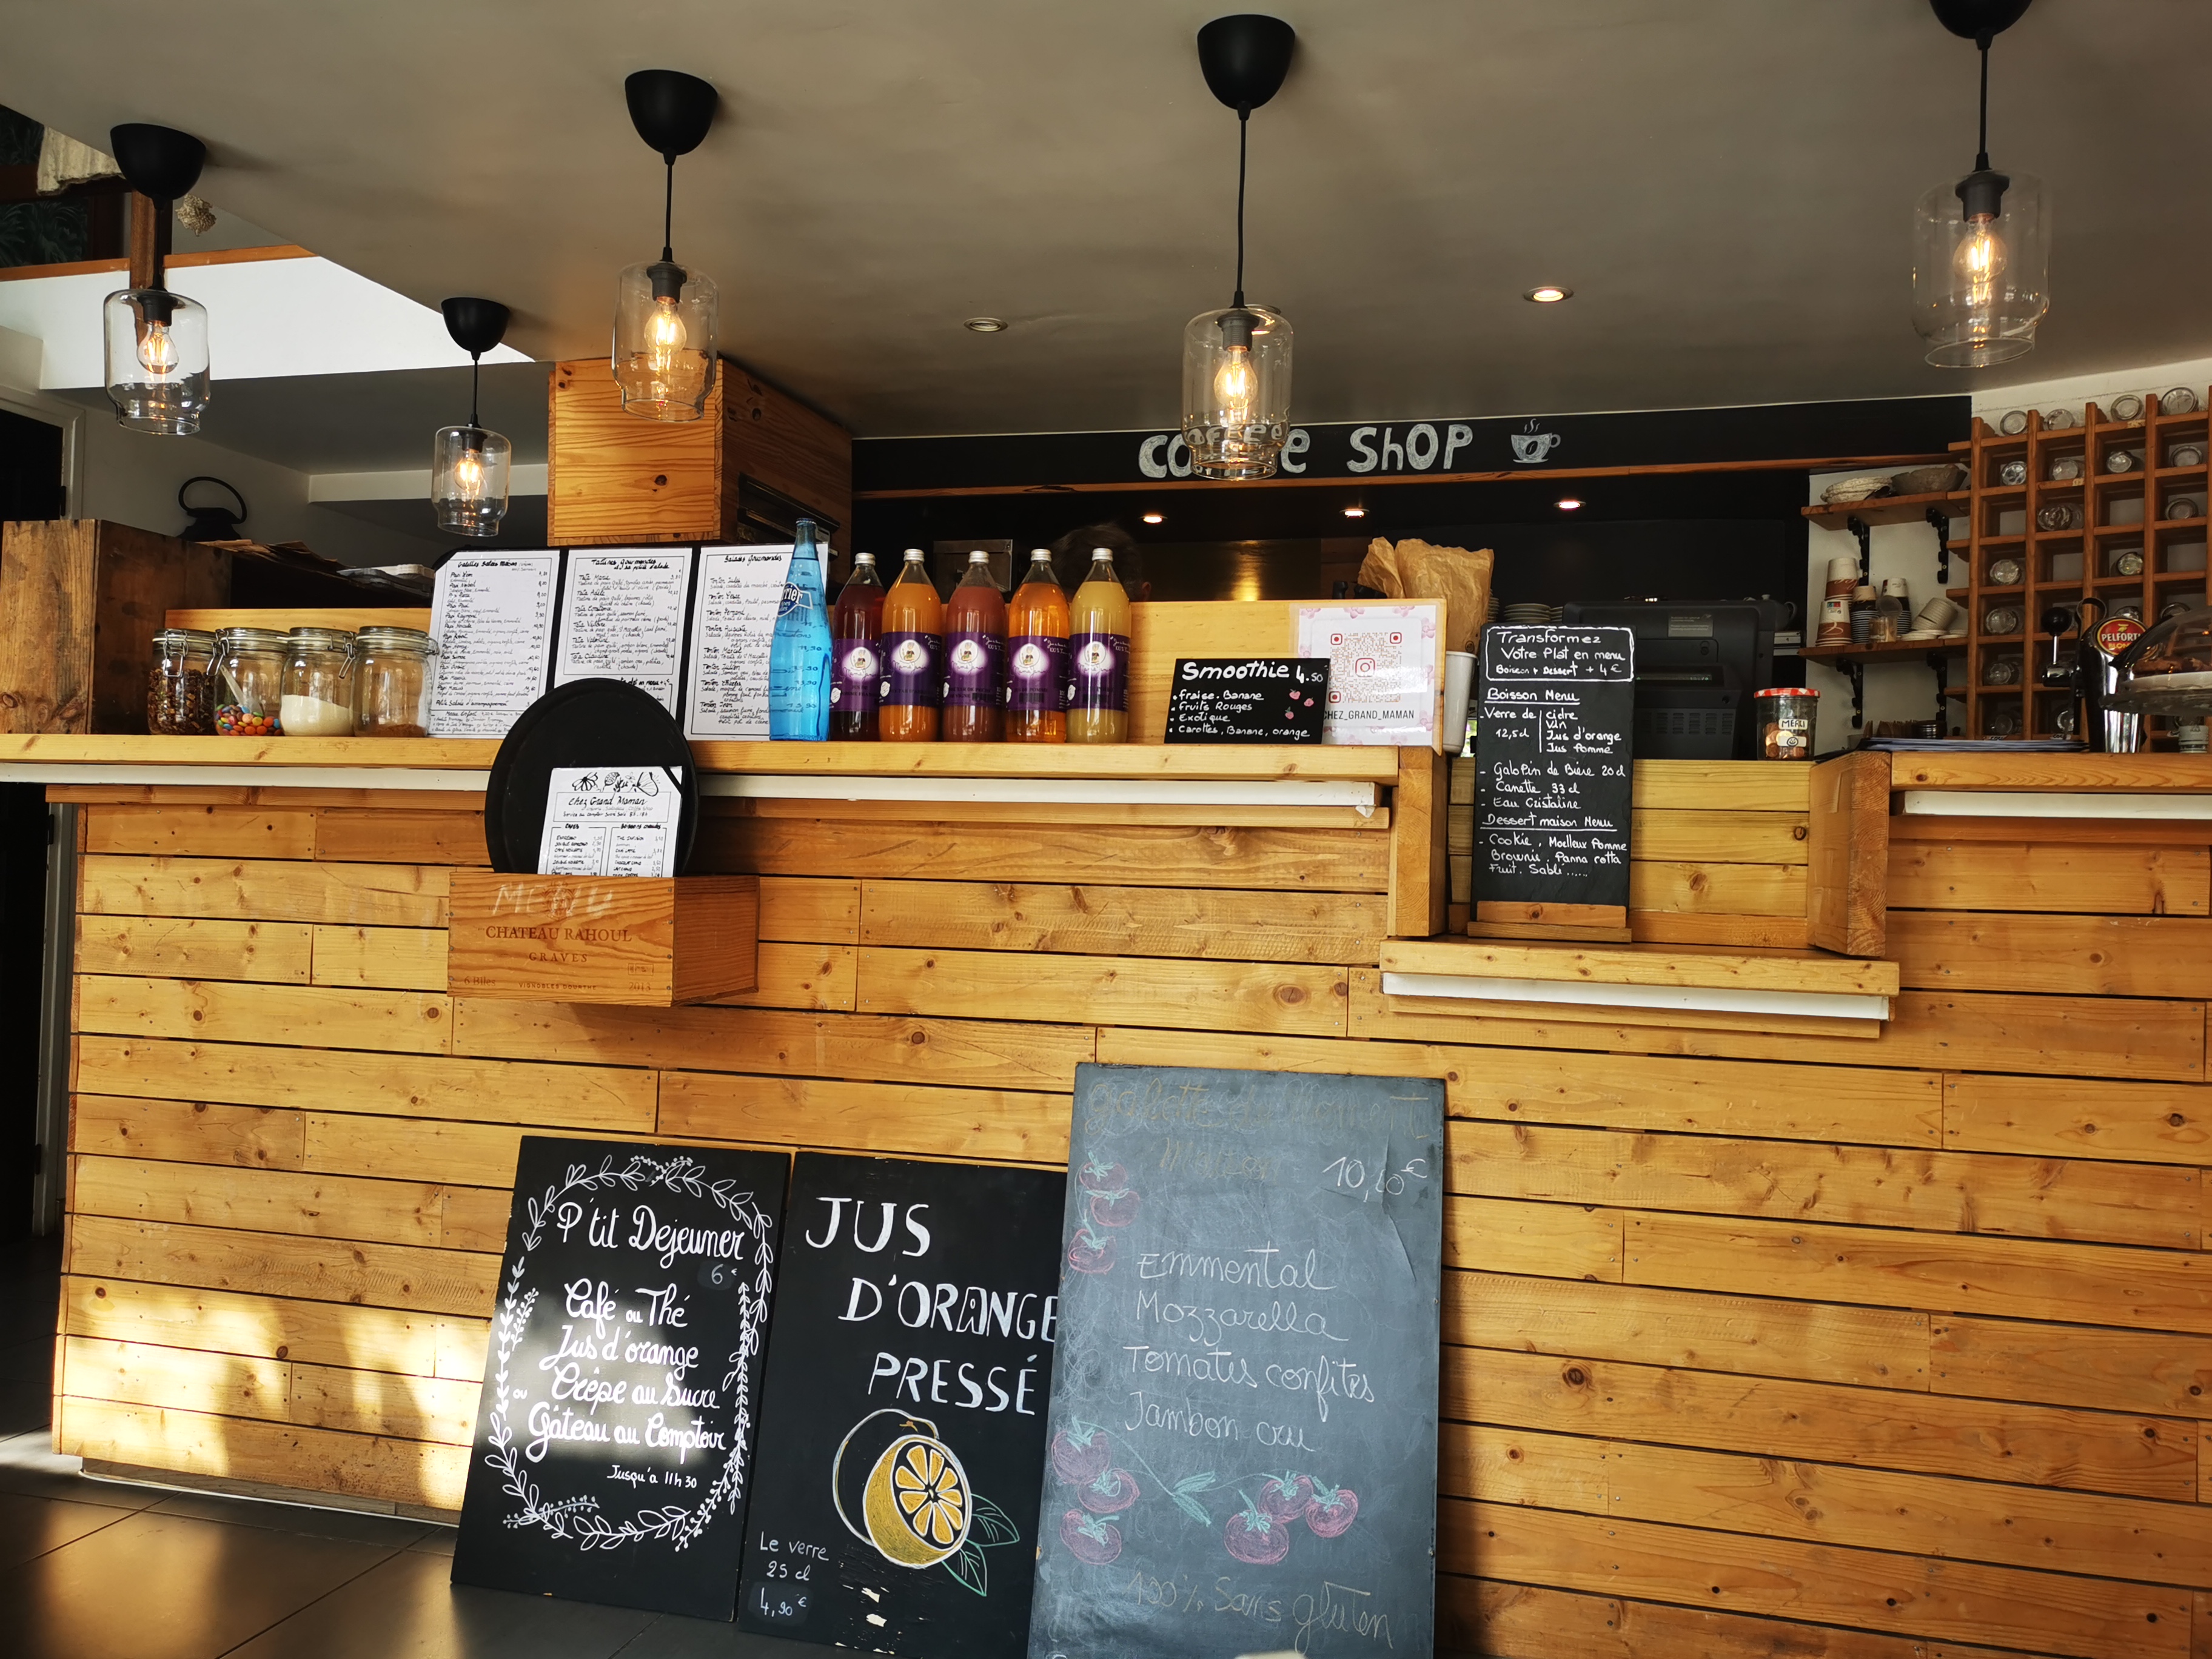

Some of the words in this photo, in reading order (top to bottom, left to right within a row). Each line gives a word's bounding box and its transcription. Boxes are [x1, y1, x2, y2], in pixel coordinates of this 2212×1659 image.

[1496, 629, 1601, 644] Transformez
[1501, 646, 1537, 660] Votre
[1543, 646, 1569, 660] Plat
[1574, 651, 1589, 660] en
[1594, 652, 1626, 660] menu
[1182, 661, 1290, 680] Smoothie
[1543, 660, 1578, 676] Dessert
[1223, 690, 1264, 701] Banane
[1487, 688, 1537, 700] Boisson
[1546, 689, 1580, 702] Menu
[1215, 702, 1253, 712] Rouges
[1522, 707, 1537, 719] de
[1179, 711, 1230, 723] Exotique
[1546, 720, 1567, 729] Vin
[1272, 728, 1310, 741] orange
[1546, 730, 1569, 740] Jus
[1574, 726, 1621, 745] d'orange
[1546, 743, 1567, 752] Jus
[1547, 760, 1559, 776] de
[1496, 779, 1541, 794] Canette
[590, 796, 613, 805] Grand
[617, 796, 648, 805] Maman
[1493, 797, 1520, 808] Eau
[1526, 793, 1581, 809] Cristaline
[1482, 811, 1537, 826] Dessert
[1540, 815, 1577, 827] maison
[1584, 816, 1614, 827] Menu
[1549, 834, 1587, 849] Moelleux
[1555, 851, 1588, 863] Panna
[486, 926, 559, 940] CHATEAU
[564, 928, 632, 942] RAHOUL
[529, 952, 588, 962] GRAVES
[464, 976, 470, 985] 6
[629, 982, 651, 992] 2013
[557, 1198, 620, 1248] P'tit
[805, 1197, 931, 1257] JUS
[1137, 1241, 1338, 1290] Emmental
[565, 1278, 620, 1340] Café
[625, 1309, 643, 1323] ou
[635, 1282, 691, 1328] Thé
[837, 1273, 1059, 1342] D'ORANGE
[1136, 1289, 1350, 1347] Mozzarella
[539, 1325, 598, 1370] Jus
[602, 1326, 699, 1381] d'orange
[1122, 1345, 1258, 1389] Tomates
[513, 1387, 528, 1399] ou
[551, 1362, 627, 1416] Crêpe
[631, 1384, 659, 1405] au
[660, 1371, 720, 1410] Sucre
[868, 1351, 1038, 1415] PRESSÉ
[1124, 1391, 1238, 1441] Jambon
[1256, 1421, 1316, 1452] cru
[525, 1401, 611, 1463] Gâteau
[614, 1424, 641, 1445] au
[645, 1412, 727, 1465] Comptoir
[760, 1531, 779, 1552] Le
[788, 1540, 830, 1561] verre
